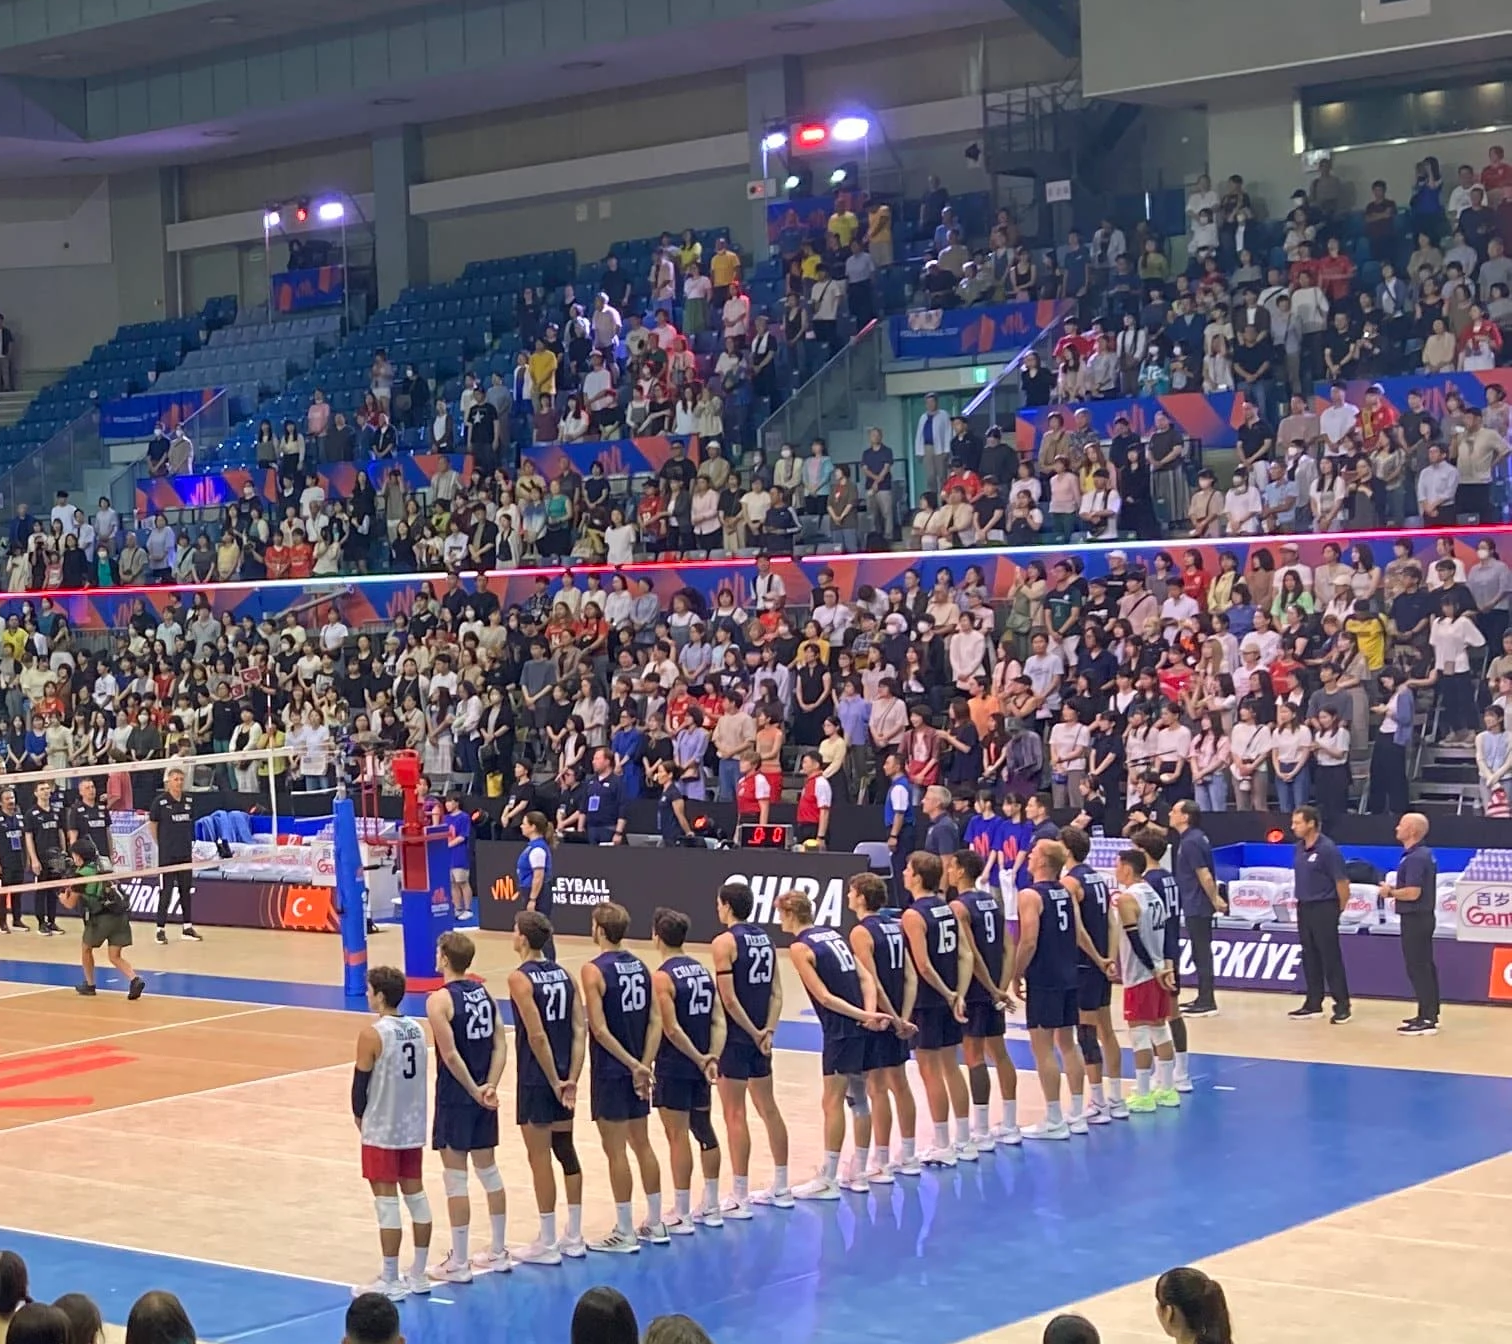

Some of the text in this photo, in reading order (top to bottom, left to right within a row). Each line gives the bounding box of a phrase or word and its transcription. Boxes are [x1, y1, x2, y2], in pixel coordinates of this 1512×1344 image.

[1057, 900, 1069, 932] 5
[1093, 883, 1107, 915] 4
[938, 919, 957, 954] 15
[984, 911, 996, 944] 9
[749, 947, 775, 984] 23
[825, 939, 856, 973] 18
[888, 933, 904, 969] 17
[543, 982, 567, 1021] 27
[619, 973, 646, 1012] 26
[688, 976, 713, 1016] 25
[465, 1001, 494, 1040] 29
[402, 1042, 416, 1079] 3
